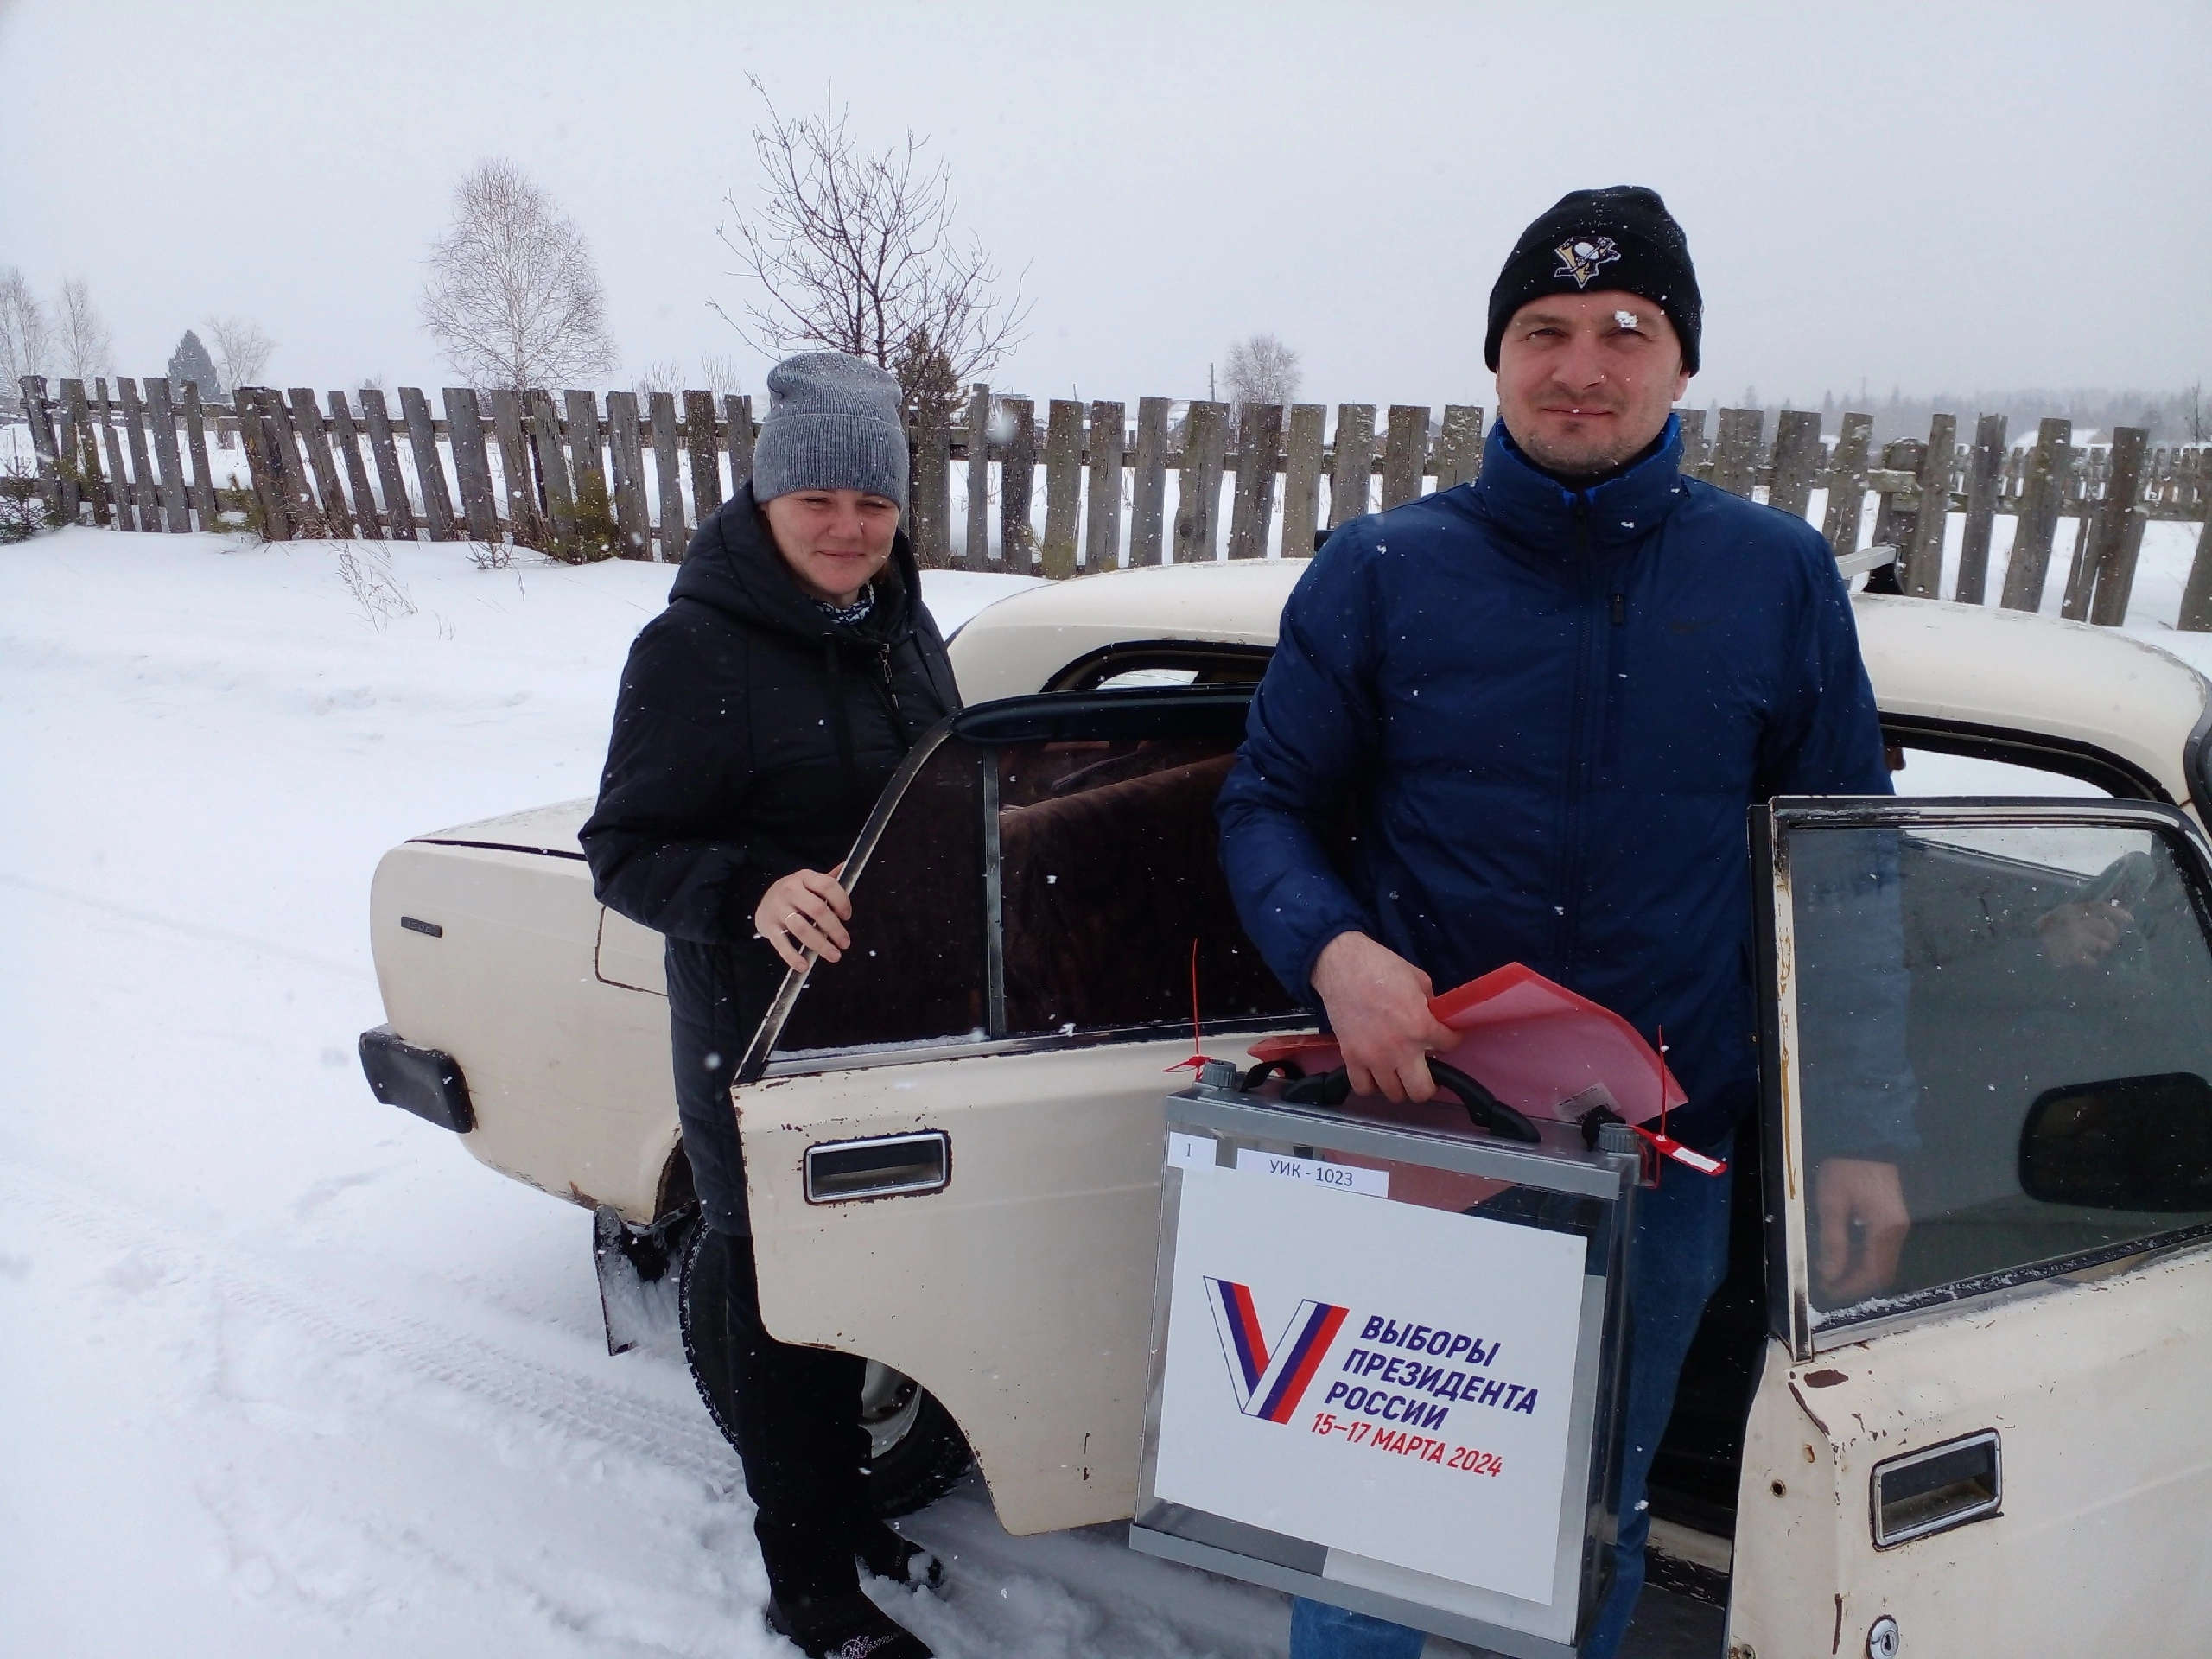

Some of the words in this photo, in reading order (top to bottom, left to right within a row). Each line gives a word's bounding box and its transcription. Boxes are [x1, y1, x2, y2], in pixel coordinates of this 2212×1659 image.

[1268, 1159, 1300, 1179] УИК
[1315, 1167, 1354, 1186] 1023
[1359, 1314, 1502, 1368] ВЫБОРЫ
[1324, 1381, 1450, 1431] РОССИИ
[1341, 1347, 1539, 1414] ПРЕЗИДЕНТА
[1370, 1427, 1446, 1465] МАРТА
[1446, 1446, 1503, 1478] 2024
